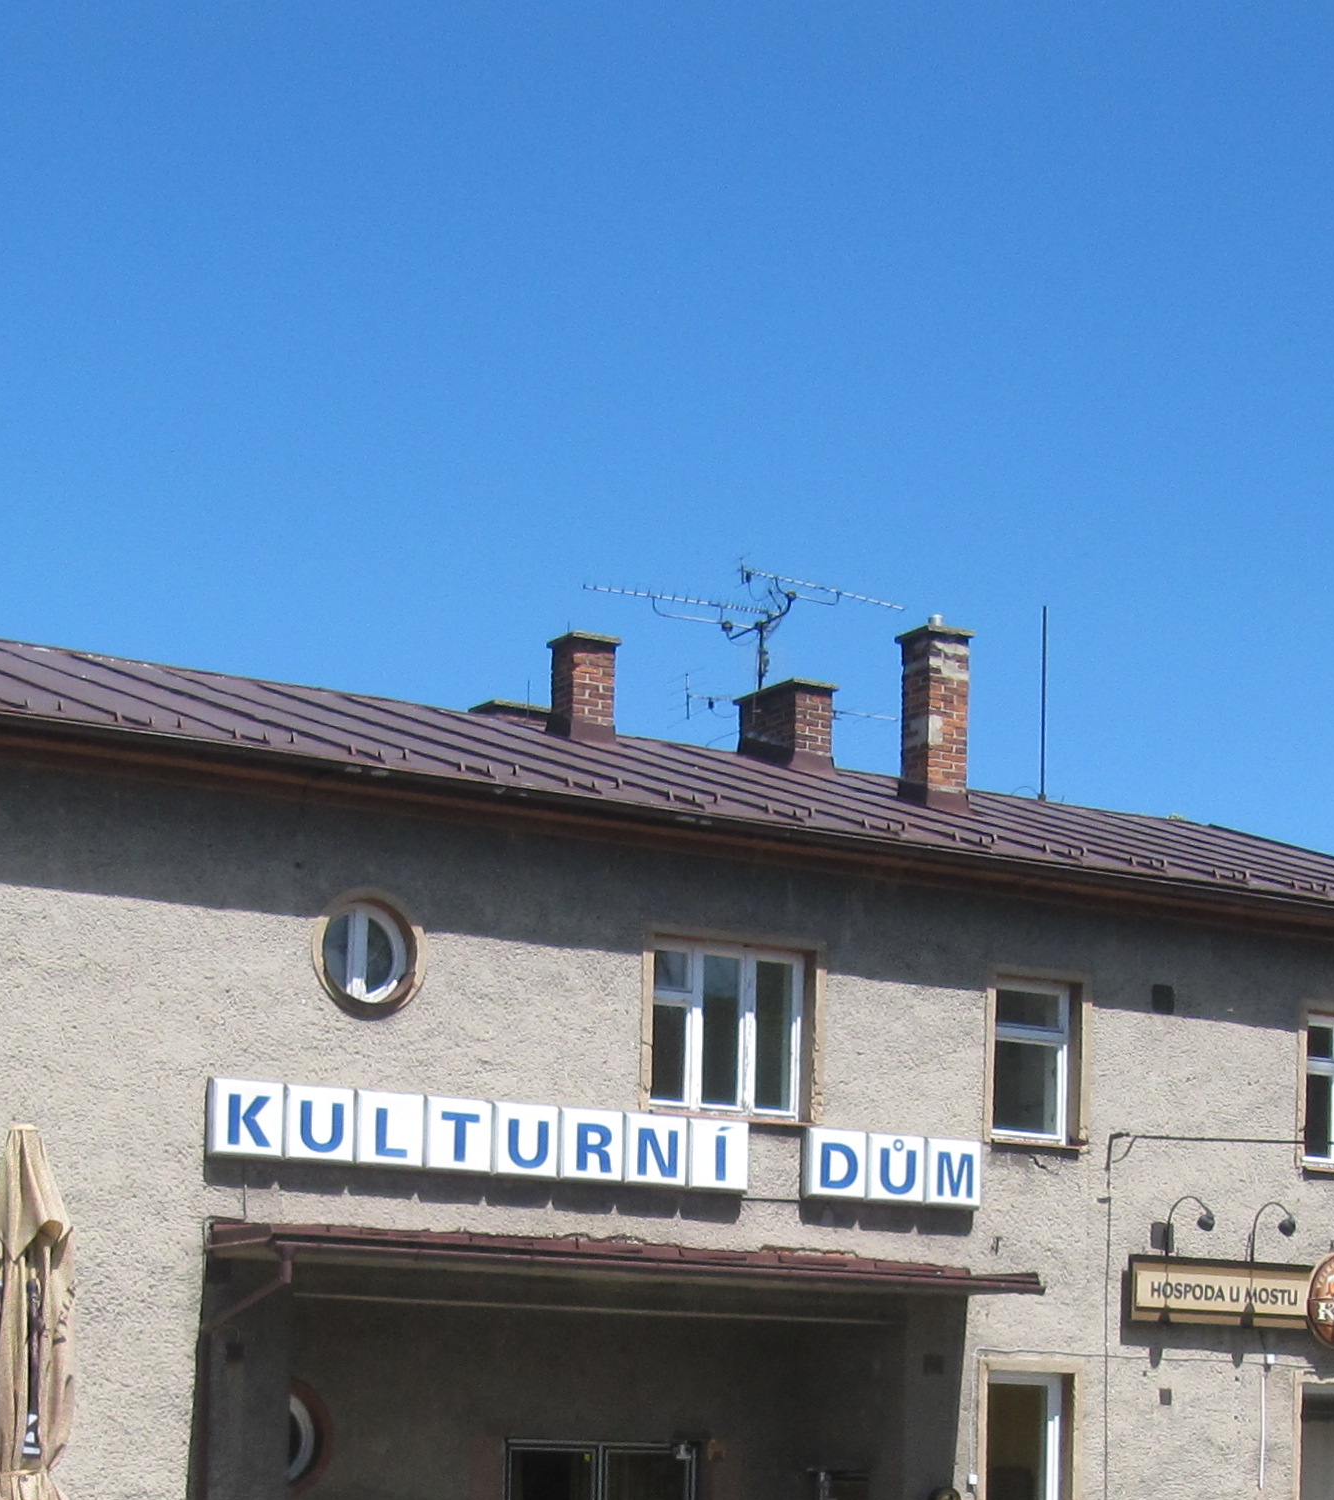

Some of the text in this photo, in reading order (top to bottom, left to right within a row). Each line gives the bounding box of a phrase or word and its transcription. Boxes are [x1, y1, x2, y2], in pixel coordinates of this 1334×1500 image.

[227, 1093, 974, 1199] KULTURNÍ DŮM
[1150, 1281, 1298, 1306] HOSPODA U MOSTU
